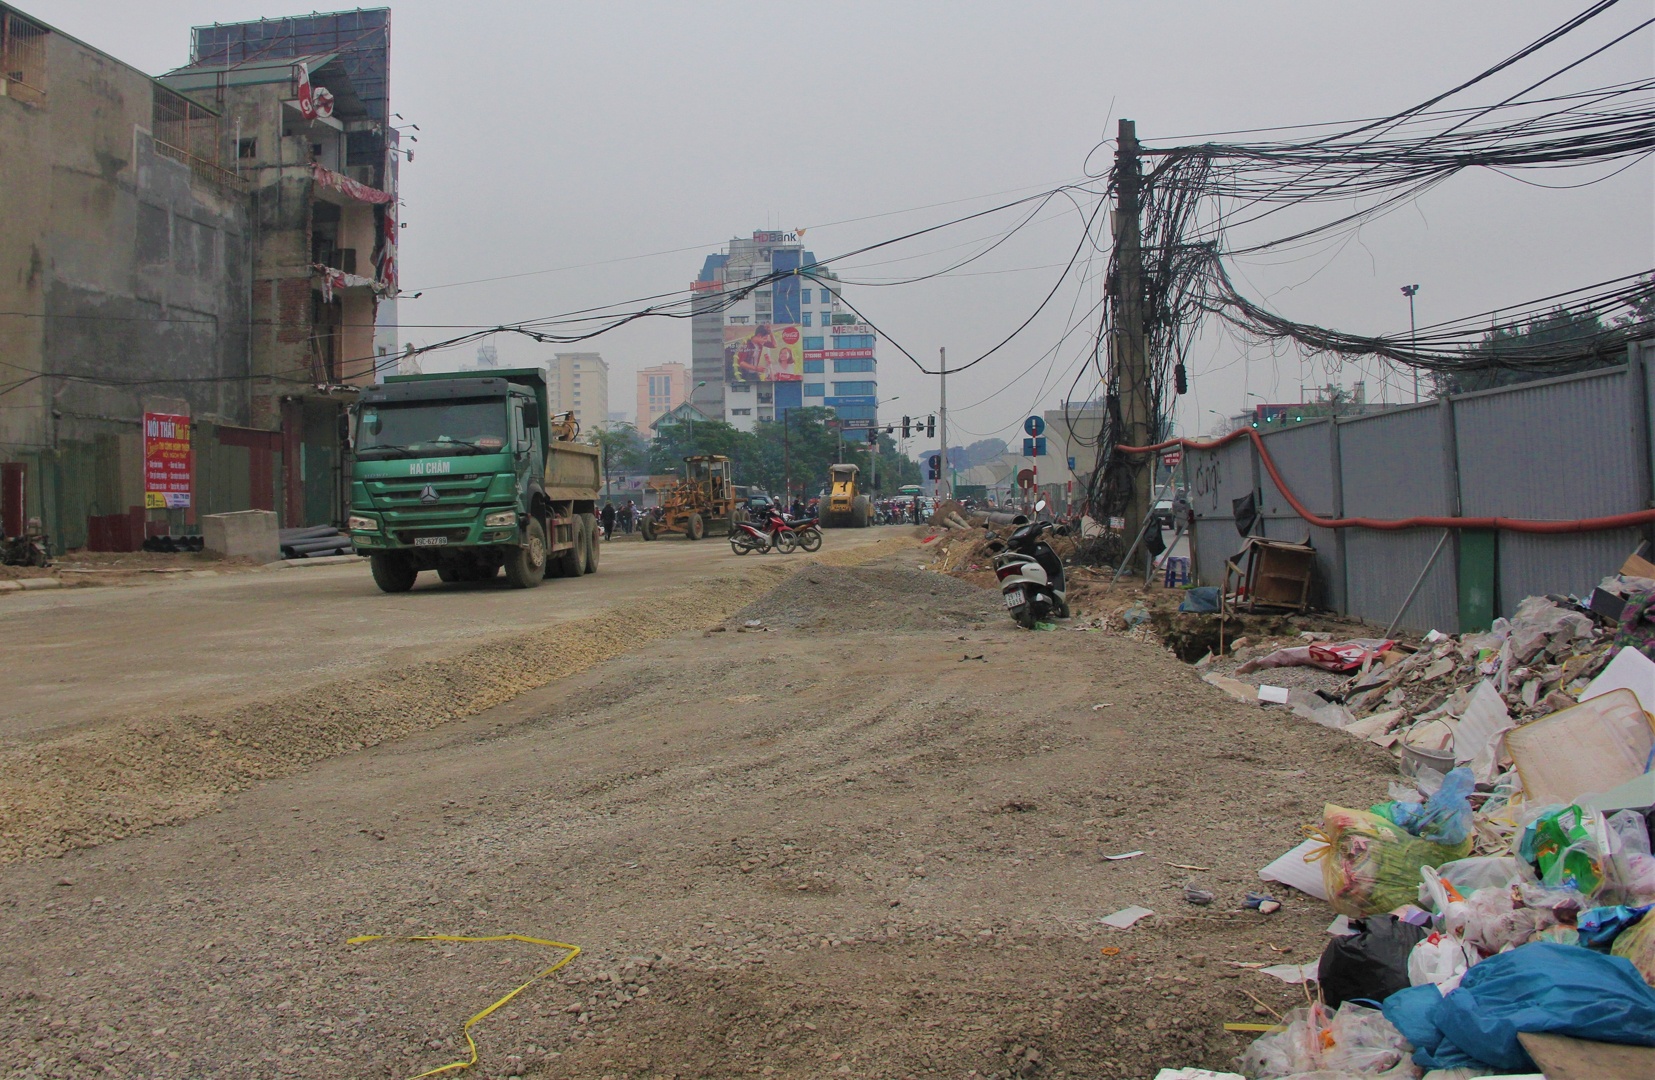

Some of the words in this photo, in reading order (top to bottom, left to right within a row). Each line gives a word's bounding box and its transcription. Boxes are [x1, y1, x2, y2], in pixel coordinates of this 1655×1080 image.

[753, 231, 797, 243] HDBank
[147, 416, 159, 441] NỘI
[160, 416, 175, 439] THẤT
